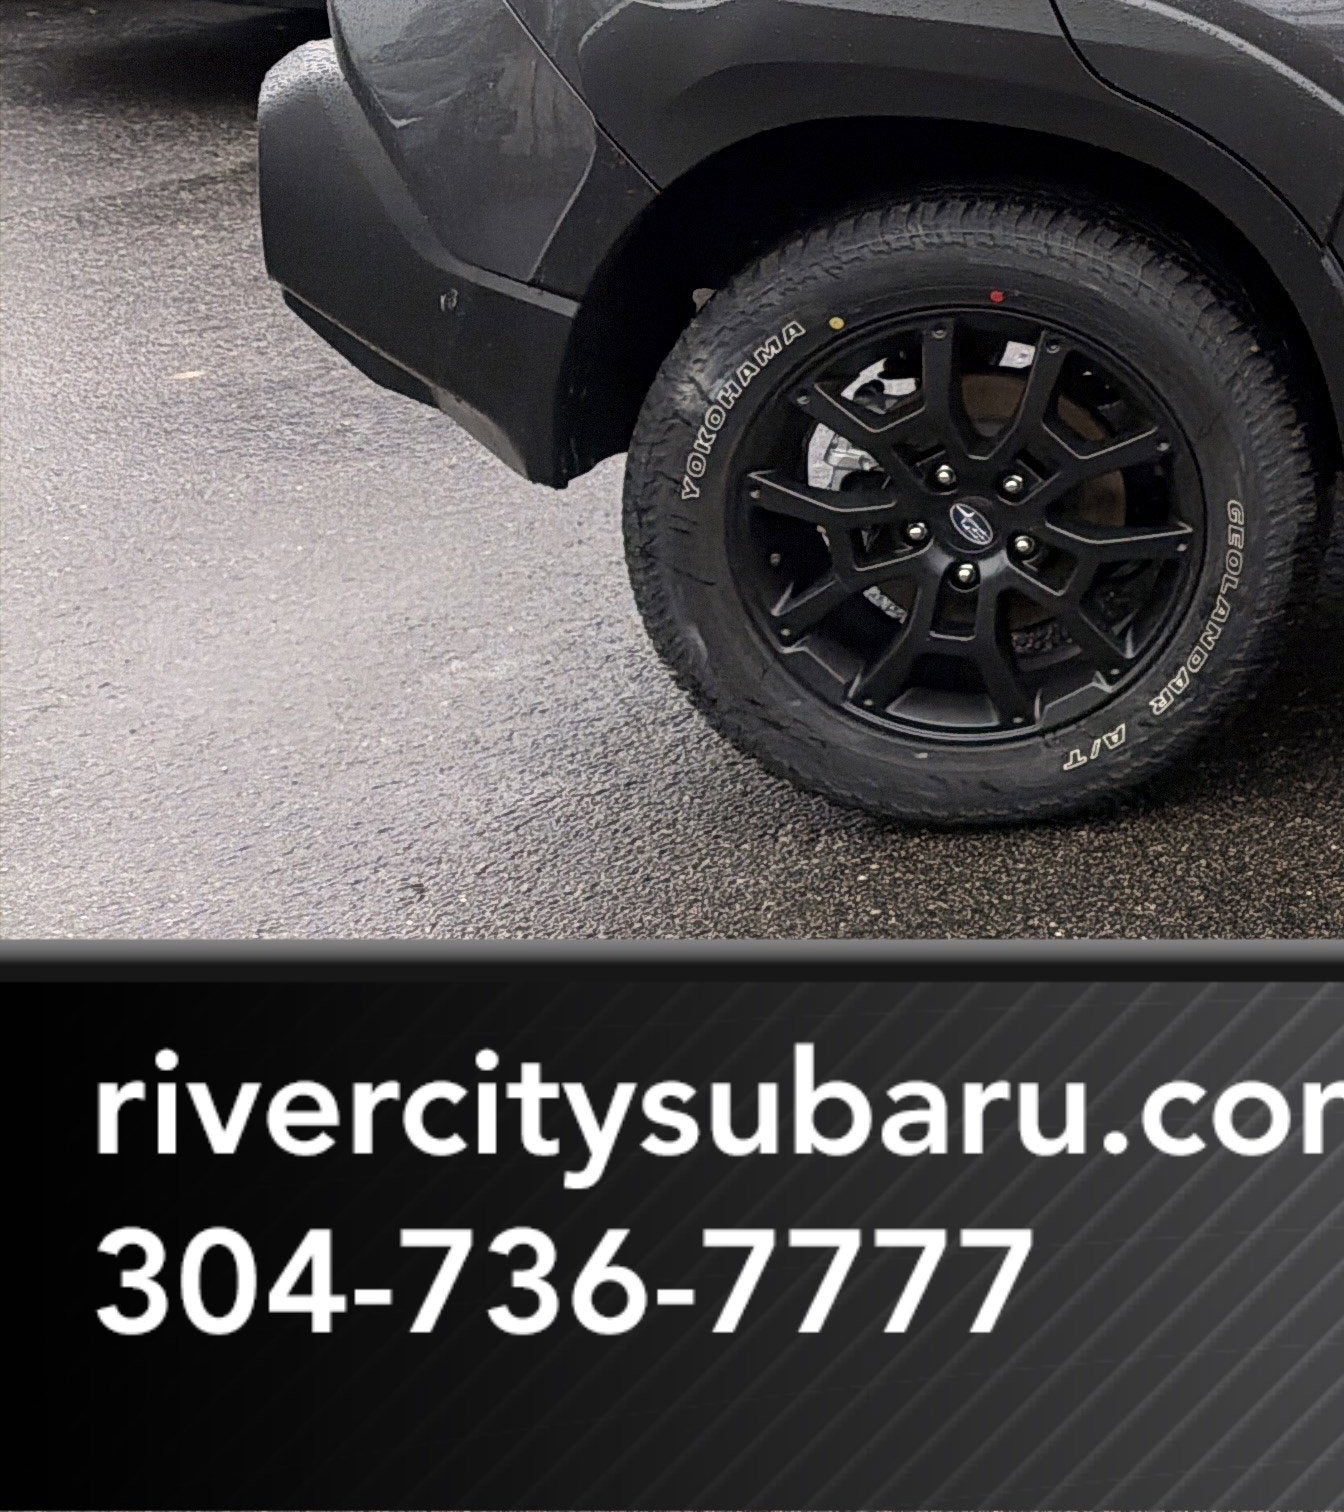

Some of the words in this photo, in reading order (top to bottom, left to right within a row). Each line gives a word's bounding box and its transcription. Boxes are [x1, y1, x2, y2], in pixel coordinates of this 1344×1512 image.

[681, 320, 806, 500] YOKOHAMA
[1149, 499, 1245, 716] GEOLANDAR
[1063, 723, 1126, 770] A/T
